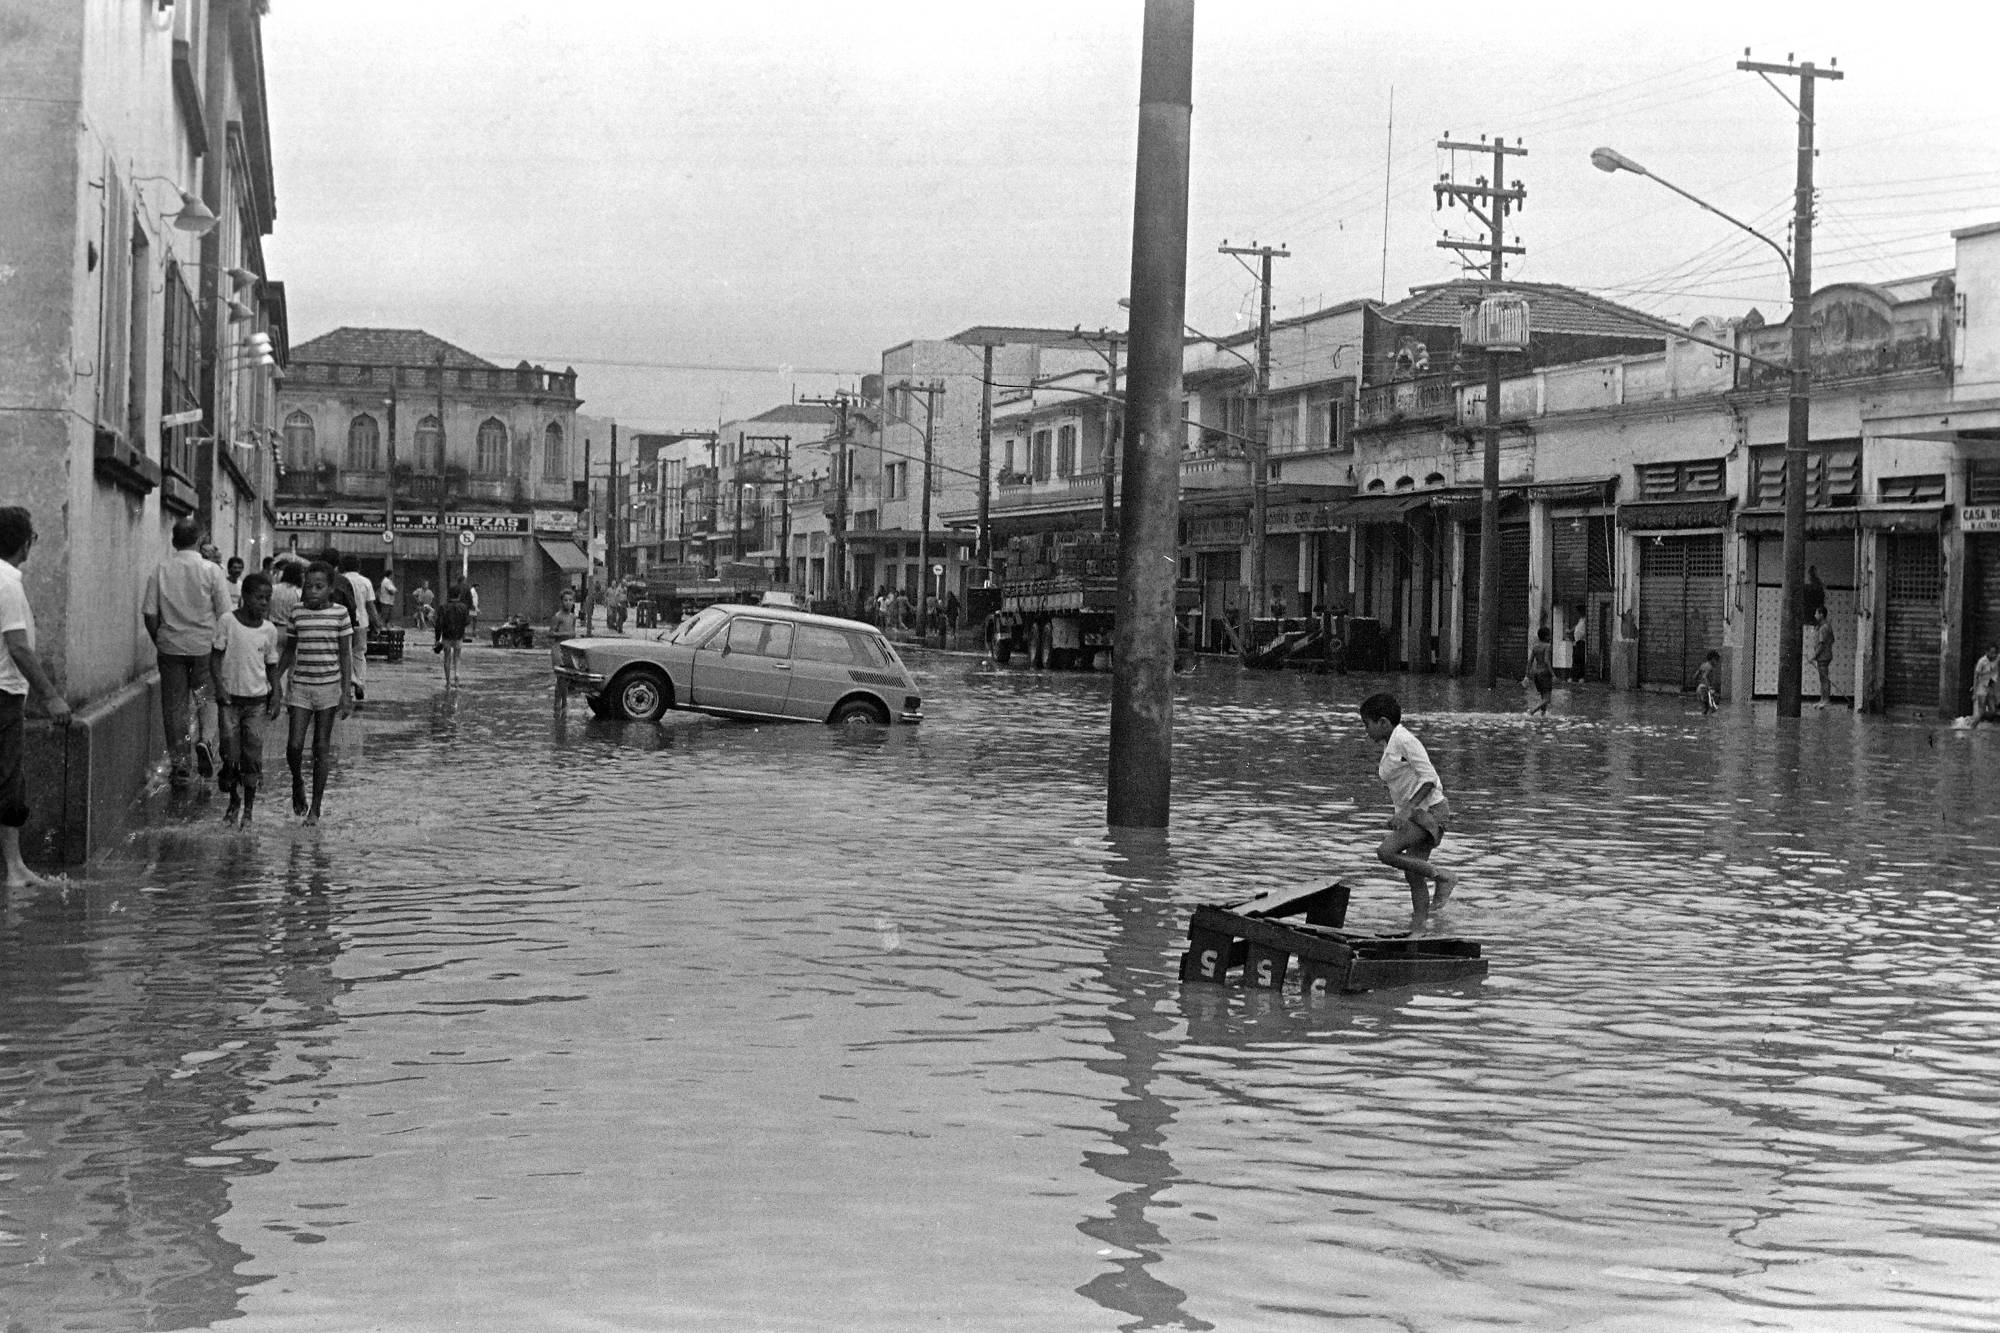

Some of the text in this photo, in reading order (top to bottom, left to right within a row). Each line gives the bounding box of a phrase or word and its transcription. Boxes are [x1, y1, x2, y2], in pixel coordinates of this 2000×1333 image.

[276, 511, 348, 522] MPERIO
[422, 515, 519, 527] MUDEZAS
[1963, 509, 1985, 521] CASA
[1200, 950, 1218, 978] S
[1257, 958, 1272, 987] S
